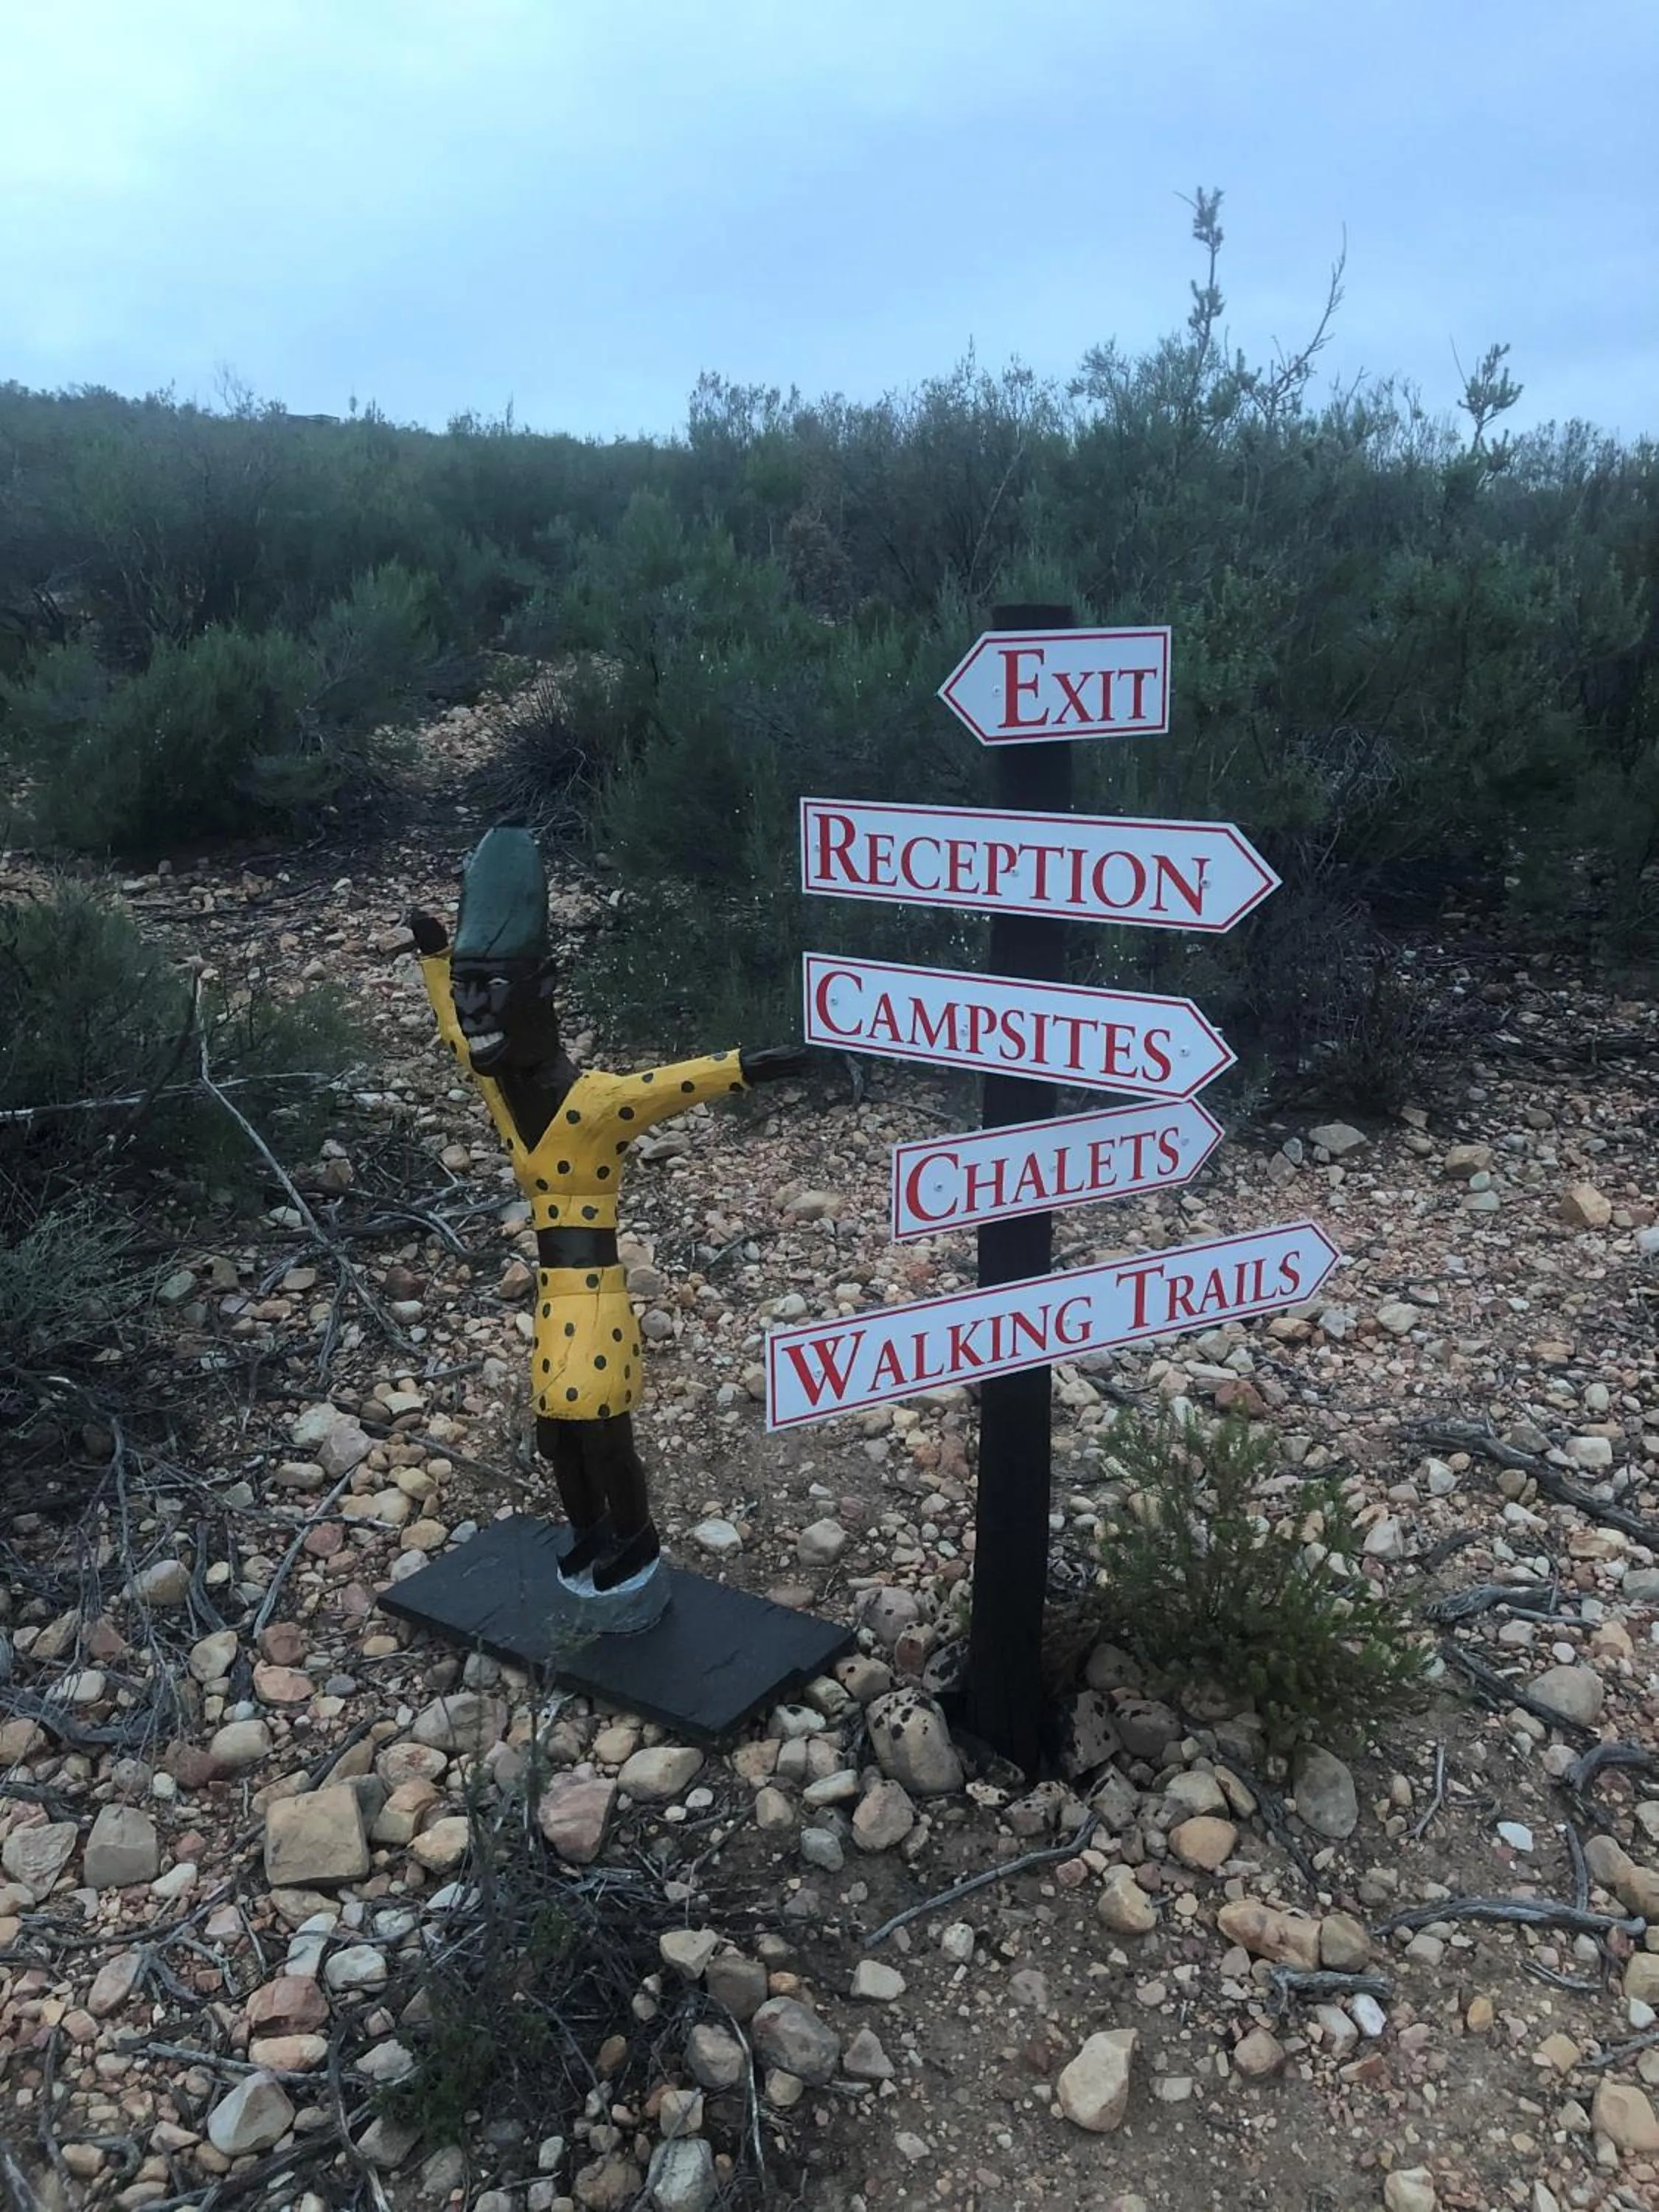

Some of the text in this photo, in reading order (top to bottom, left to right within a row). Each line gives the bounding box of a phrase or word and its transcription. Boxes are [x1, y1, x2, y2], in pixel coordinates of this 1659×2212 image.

[997, 648, 1158, 728] EXIT
[813, 813, 1210, 916] RECEPTION
[815, 971, 1171, 1082] CAMPSITES
[905, 1127, 1180, 1221] CHALETS
[782, 1251, 1301, 1407] WALKING TRAILS
